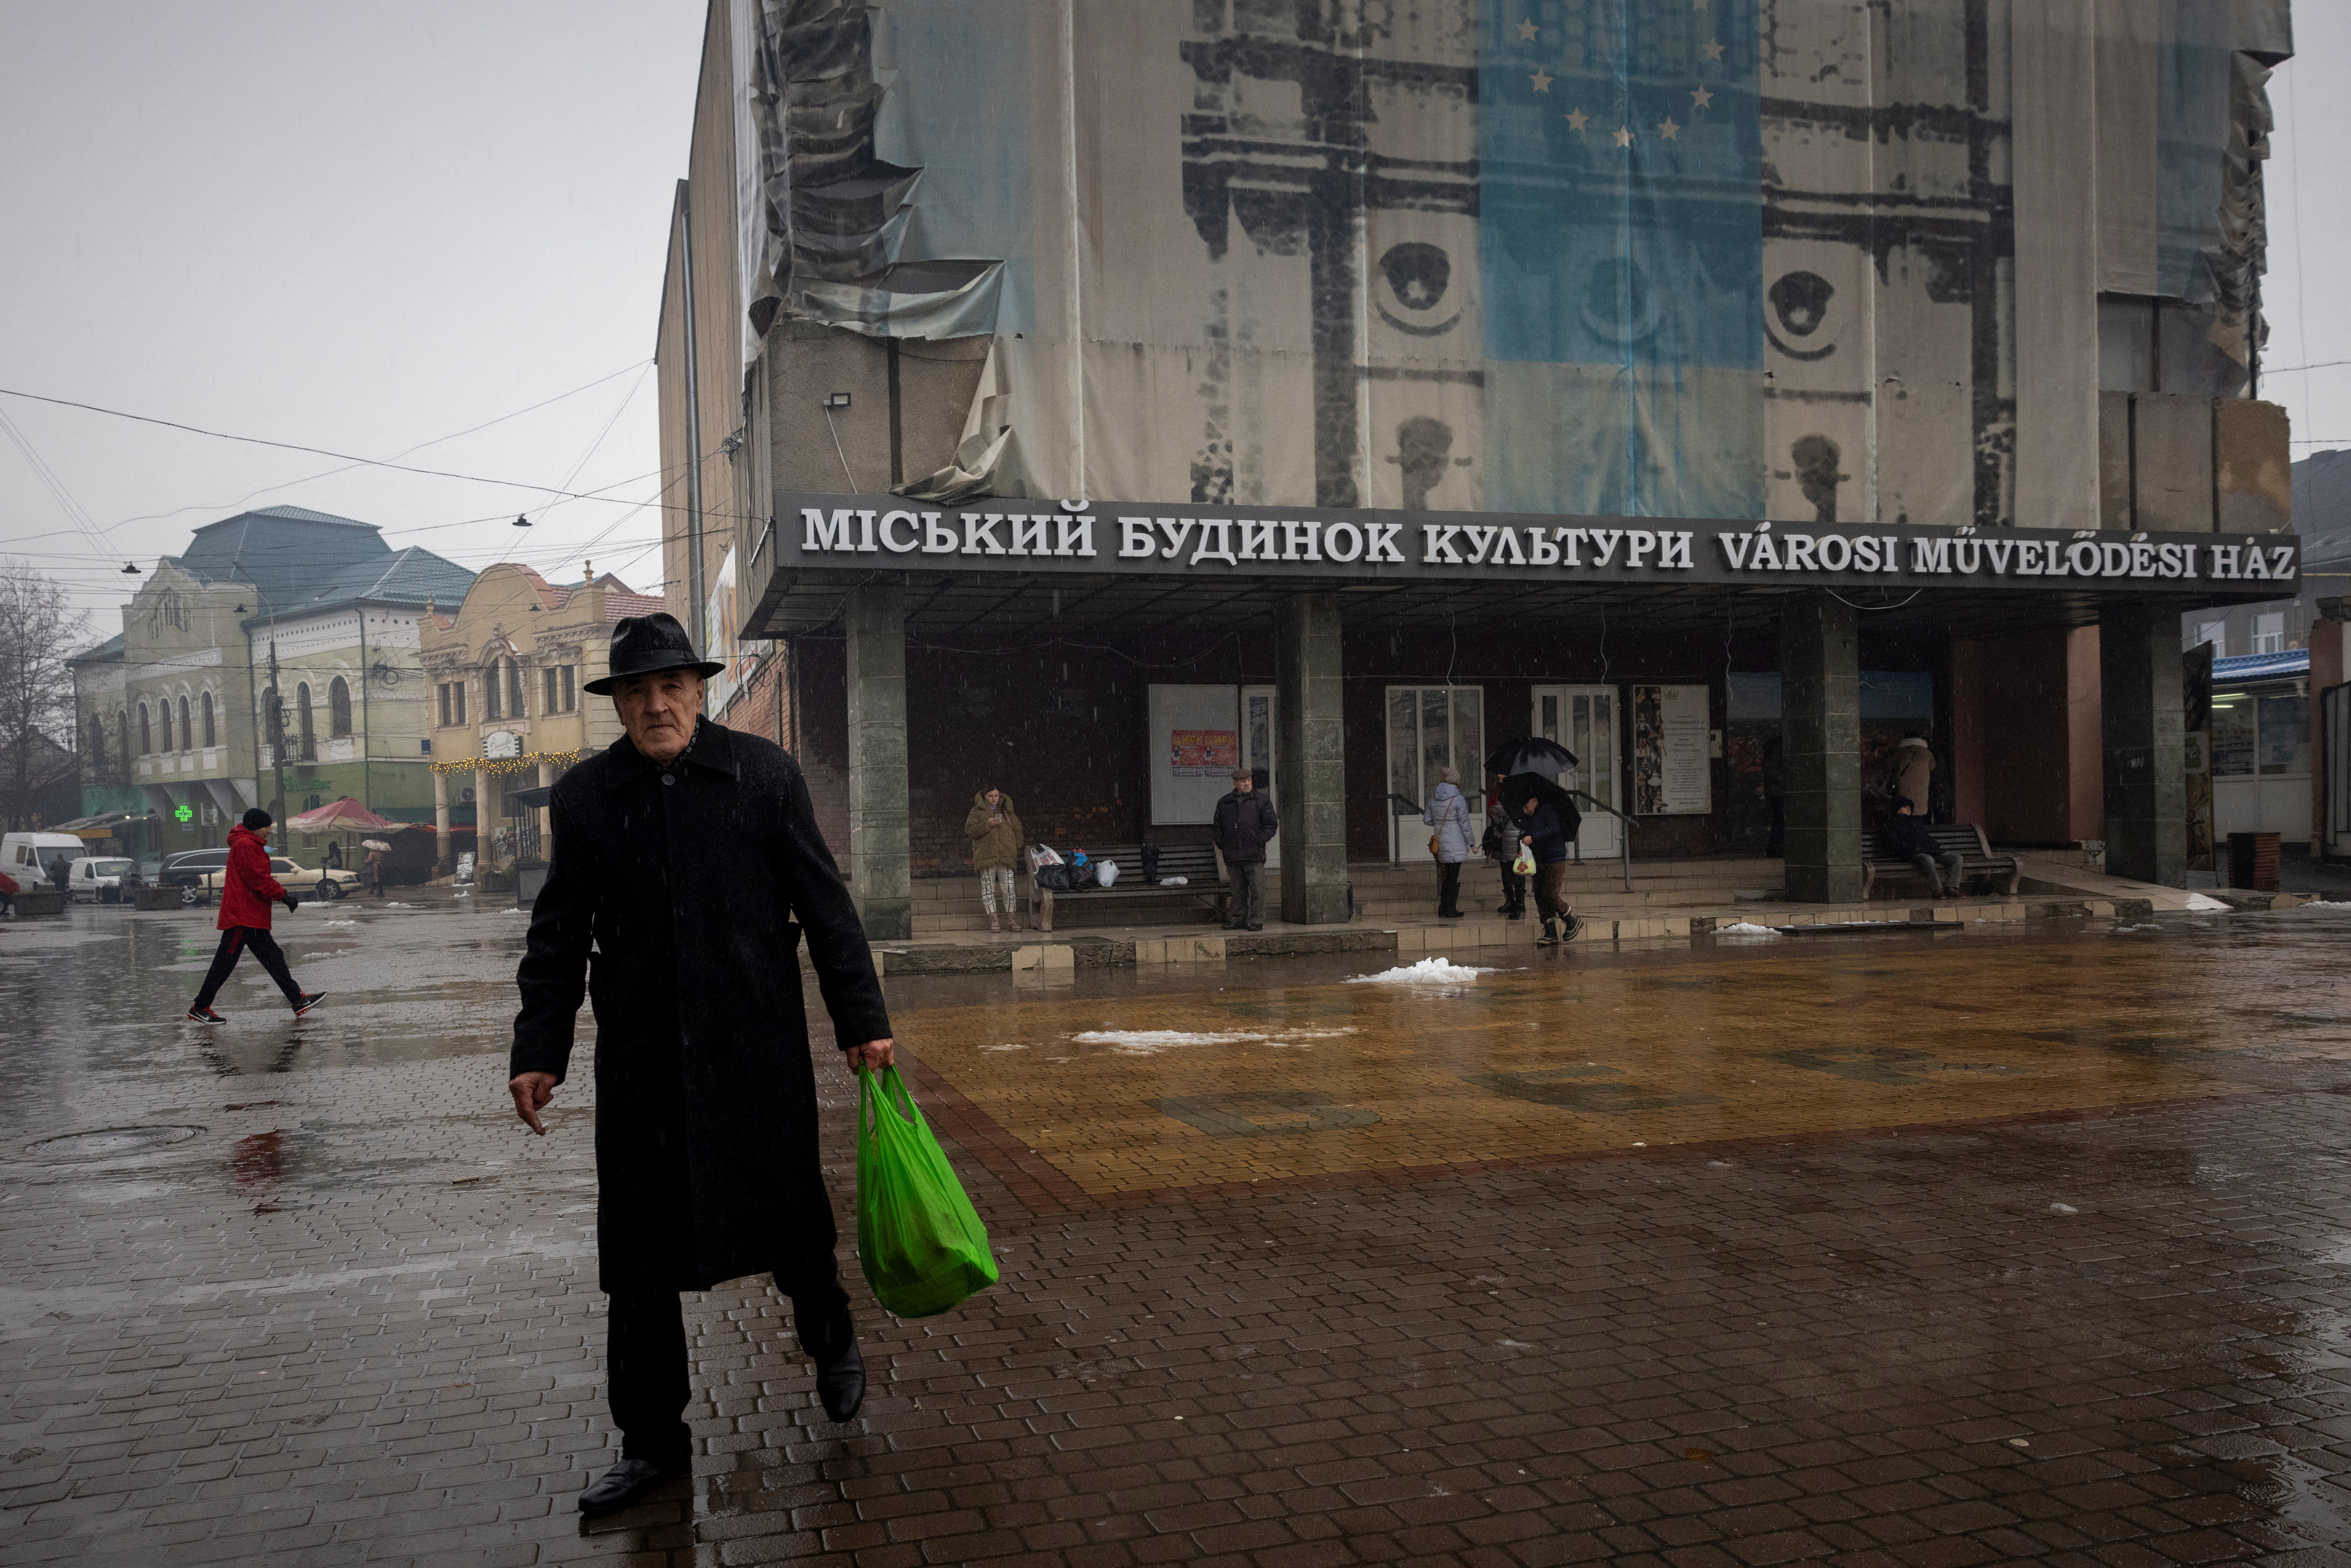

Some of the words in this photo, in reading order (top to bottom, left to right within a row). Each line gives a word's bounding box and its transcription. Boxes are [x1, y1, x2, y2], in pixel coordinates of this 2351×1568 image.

[800, 499, 1097, 556] МІСЬКИЙ
[1118, 516, 1405, 566] БУДИНОК
[1422, 524, 1694, 568] КУЛЬТУРИ
[1716, 521, 1899, 572] VÁROSI
[1911, 526, 2198, 578] MŰVELŐDÉSI
[2210, 536, 2296, 579] HÁZ
[1173, 735, 1202, 746] ЦИРК
[1205, 735, 1234, 745] ЦИРК
